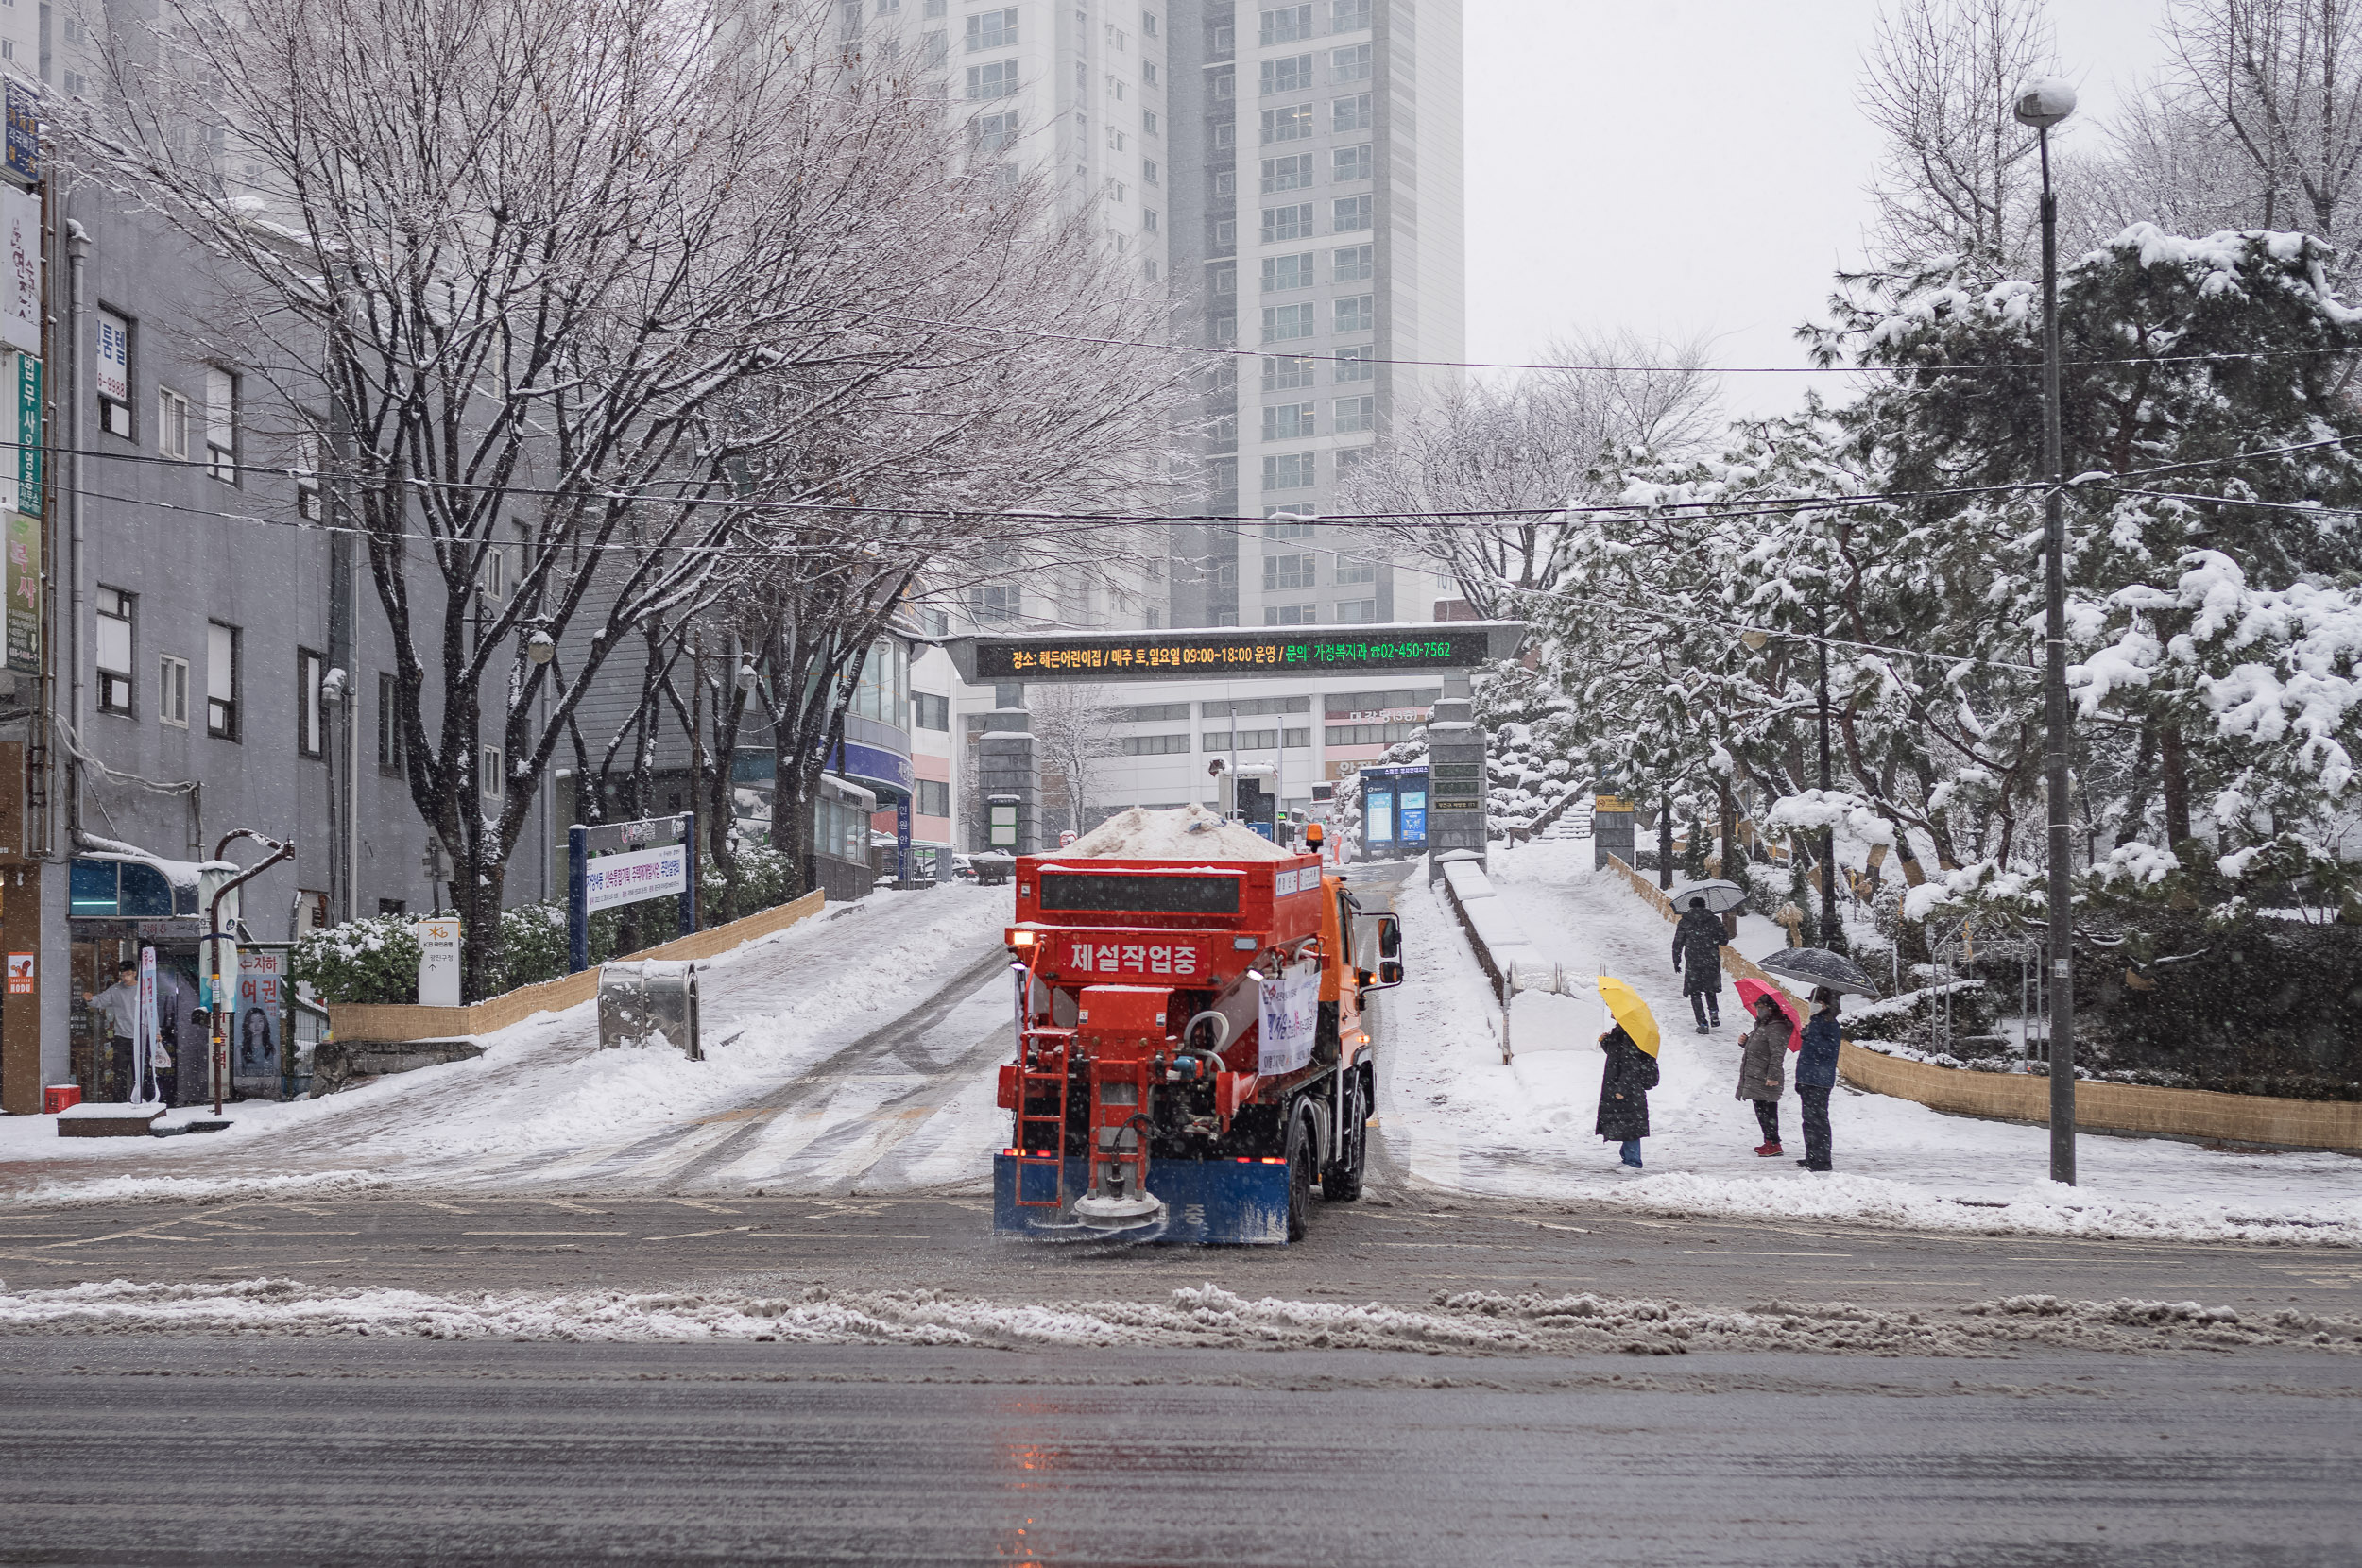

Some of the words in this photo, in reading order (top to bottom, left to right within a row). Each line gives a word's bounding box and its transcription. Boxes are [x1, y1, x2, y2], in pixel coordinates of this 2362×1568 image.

[24, 356, 35, 435] 법무사
[10, 539, 36, 609] 복사
[1013, 651, 1036, 669] 장소:
[1111, 649, 1133, 667] 매주
[1183, 647, 1253, 663] 09:00~18:00
[1254, 645, 1275, 663] 운영
[1285, 644, 1310, 662] 문의:
[1314, 643, 1367, 662] 가정복지과
[253, 955, 279, 974] 지하
[1070, 944, 1197, 975] 제설작업중
[10, 983, 31, 993] HODU
[241, 979, 277, 1004] 여권
